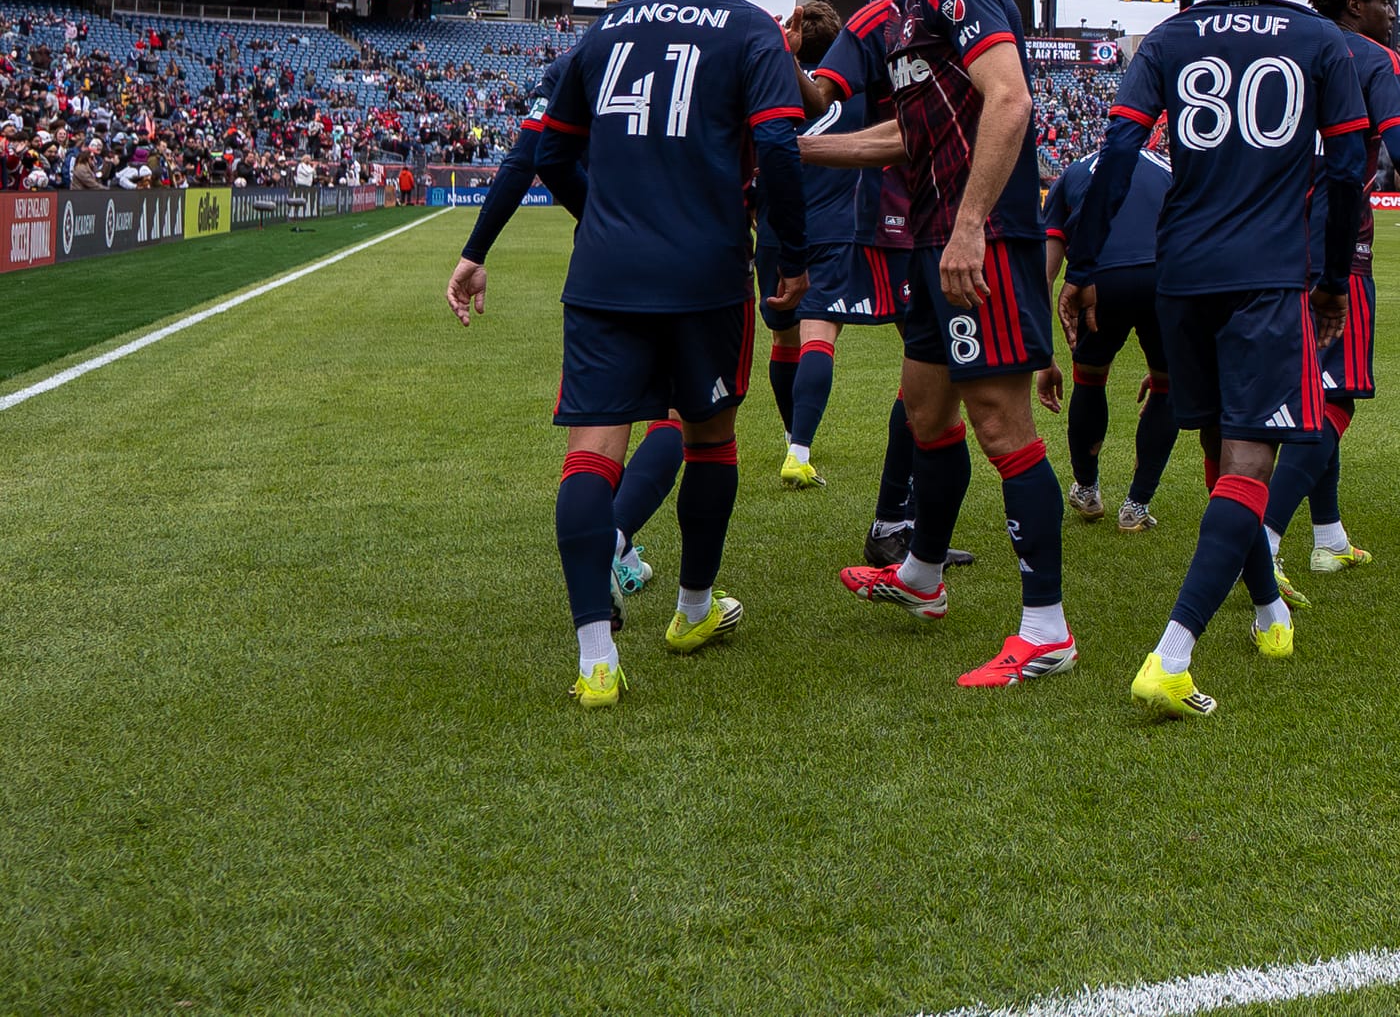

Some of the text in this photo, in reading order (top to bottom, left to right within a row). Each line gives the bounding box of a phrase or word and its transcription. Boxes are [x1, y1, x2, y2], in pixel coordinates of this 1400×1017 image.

[601, 2, 731, 30] LANGONI
[1195, 13, 1290, 37] YUSUF
[1035, 49, 1081, 61] AIR FORCE
[596, 42, 701, 137] 41
[1177, 55, 1305, 151] 80
[15, 197, 50, 220] NEW ENGLAND
[447, 192, 470, 204] Mass
[520, 193, 548, 205] gham
[948, 314, 981, 364] 8
